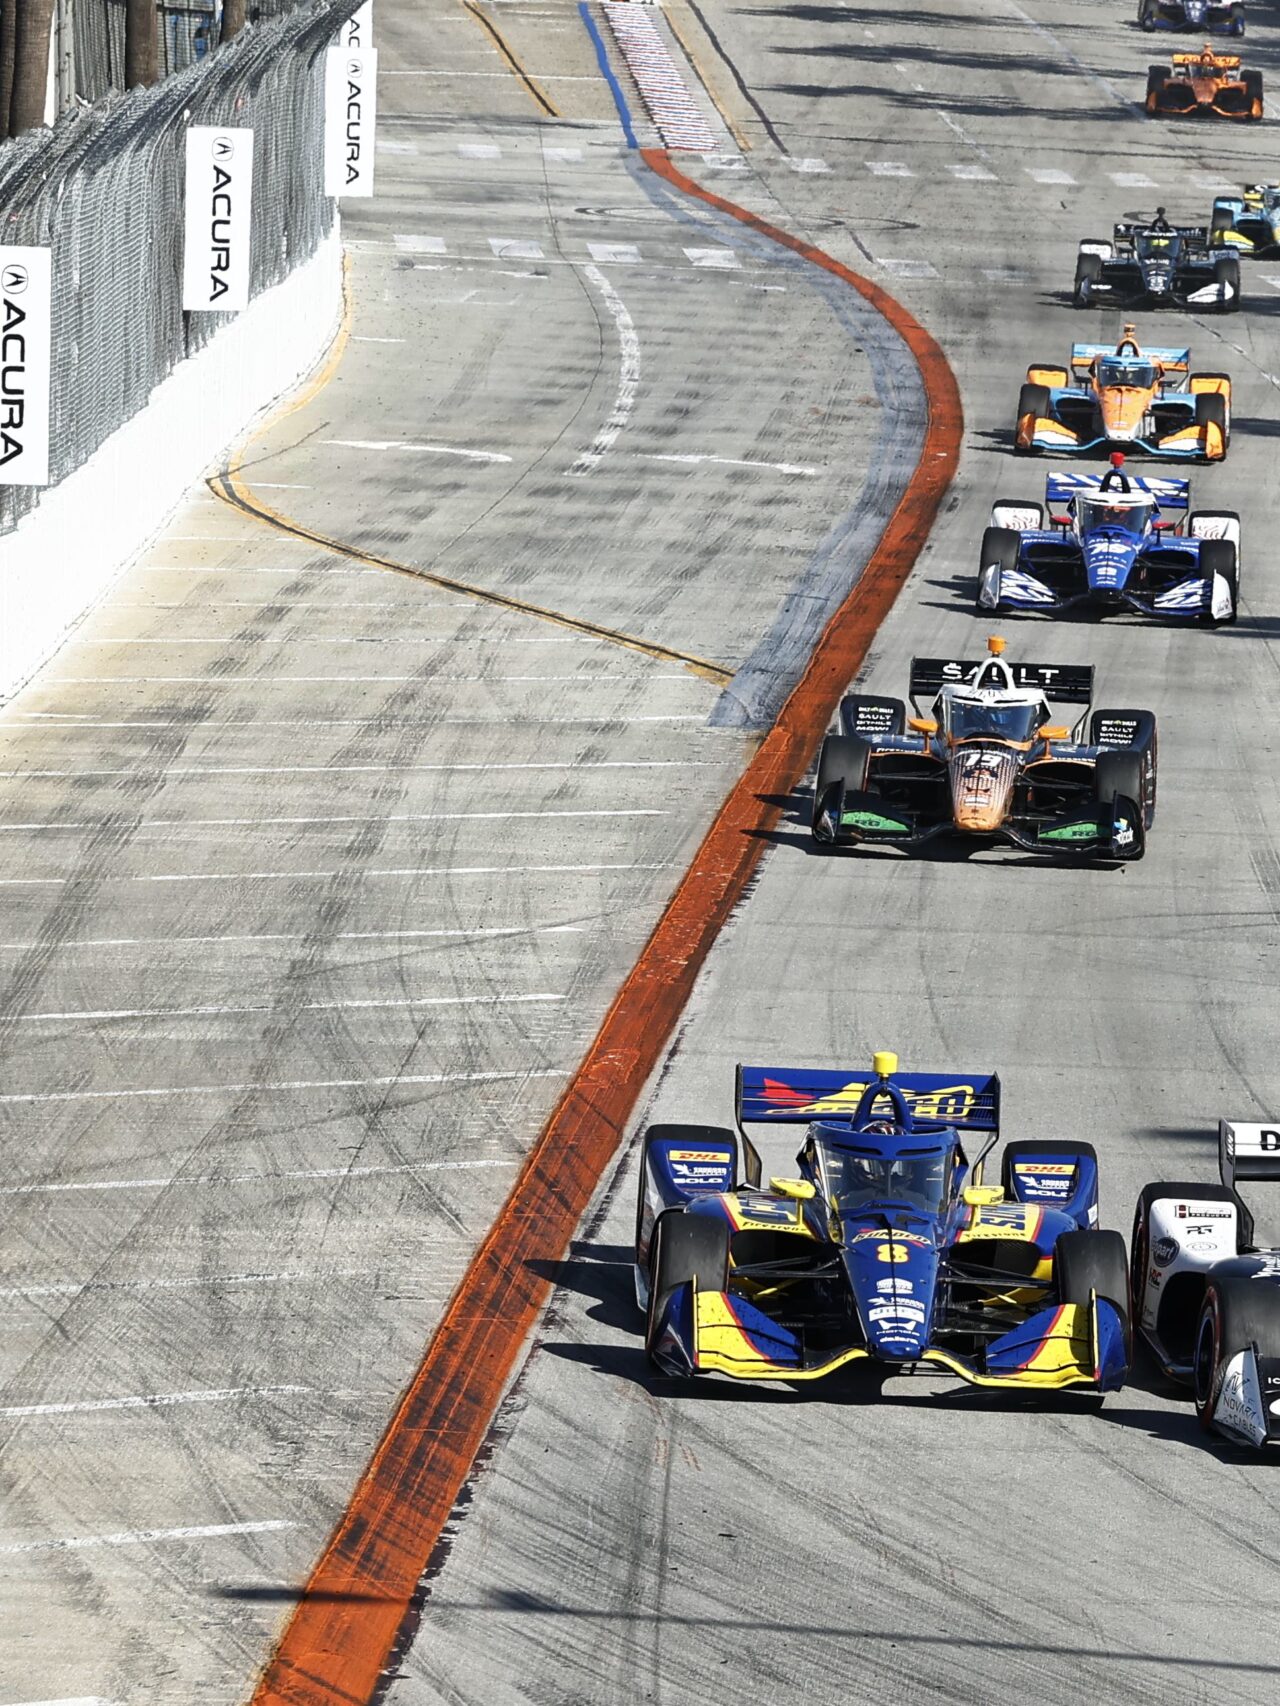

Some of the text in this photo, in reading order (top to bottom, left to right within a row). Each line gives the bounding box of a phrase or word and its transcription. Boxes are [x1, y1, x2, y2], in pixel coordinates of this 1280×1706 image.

[345, 80, 361, 185] ACURA
[209, 165, 231, 302] ACURA
[0, 298, 26, 466] ACURA
[679, 1152, 721, 1161] DHL
[1024, 1165, 1067, 1173] DHL
[876, 1243, 910, 1264] 8
[1223, 1396, 1257, 1419] NOVARA
